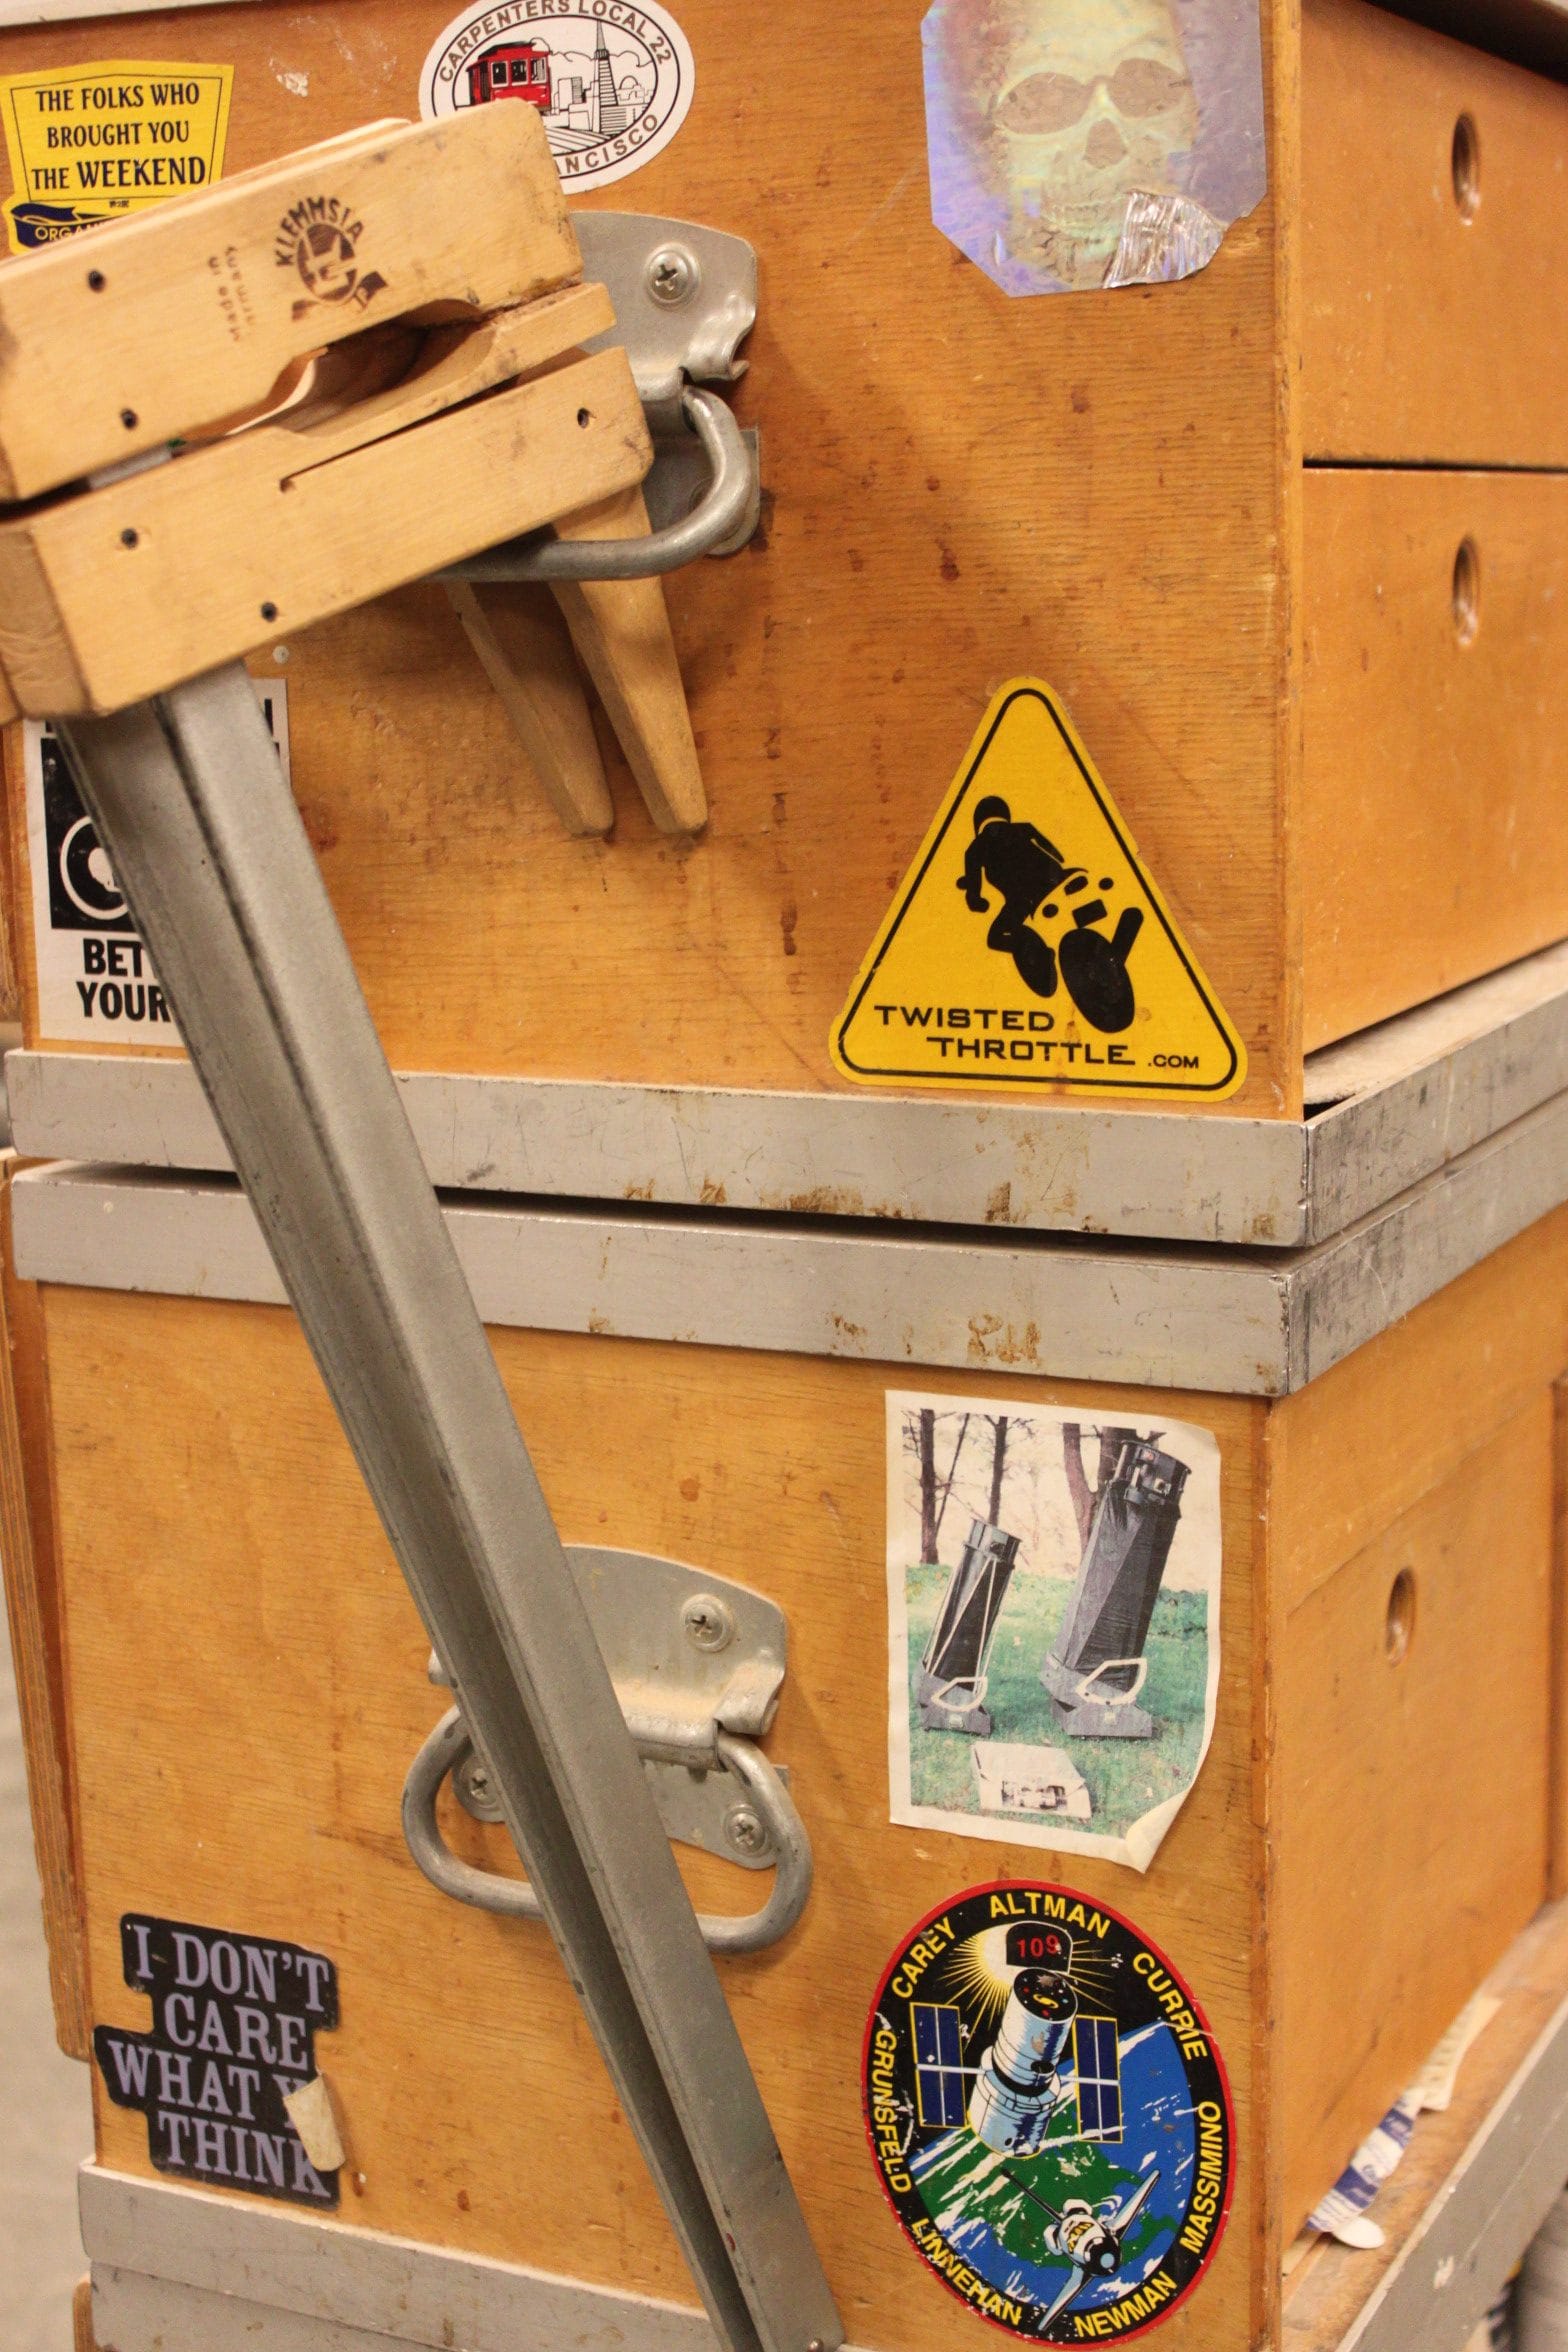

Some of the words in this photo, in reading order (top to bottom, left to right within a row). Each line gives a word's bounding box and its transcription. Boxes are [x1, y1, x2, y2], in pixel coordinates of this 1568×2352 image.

[440, 0, 570, 83] CARPENTERS
[579, 0, 646, 39] LOCAL
[650, 36, 671, 65] 22
[35, 90, 74, 112] THE
[81, 85, 144, 110] FOLKS
[150, 82, 200, 106] WHO
[47, 122, 143, 148] BROUGHT
[148, 120, 189, 143] YOU
[555, 114, 658, 174] NCISCO
[32, 167, 70, 190] THE
[76, 156, 206, 189] WEEKEND
[76, 981, 171, 1022] YOUR
[874, 1005, 1055, 1032] TWISTED
[926, 1037, 1136, 1067] THROTTLE
[1147, 1054, 1200, 1069] .COM
[989, 1891, 1111, 1939] ALTMAN
[1017, 1934, 1060, 1958] 109
[133, 1924, 154, 1980] I
[172, 1931, 330, 2012] DON'T
[891, 1917, 956, 1998] CAREY
[164, 1993, 309, 2071] CARE
[1133, 1952, 1208, 2061] CURRIE
[107, 2040, 260, 2121] WHAT
[872, 2030, 911, 2193] GRUNSFELD
[158, 2110, 332, 2199] THINK
[1180, 2101, 1221, 2254] MASSIMINO
[912, 2217, 1021, 2326] LINNEHAN
[1074, 2271, 1177, 2338] NEWMAN
